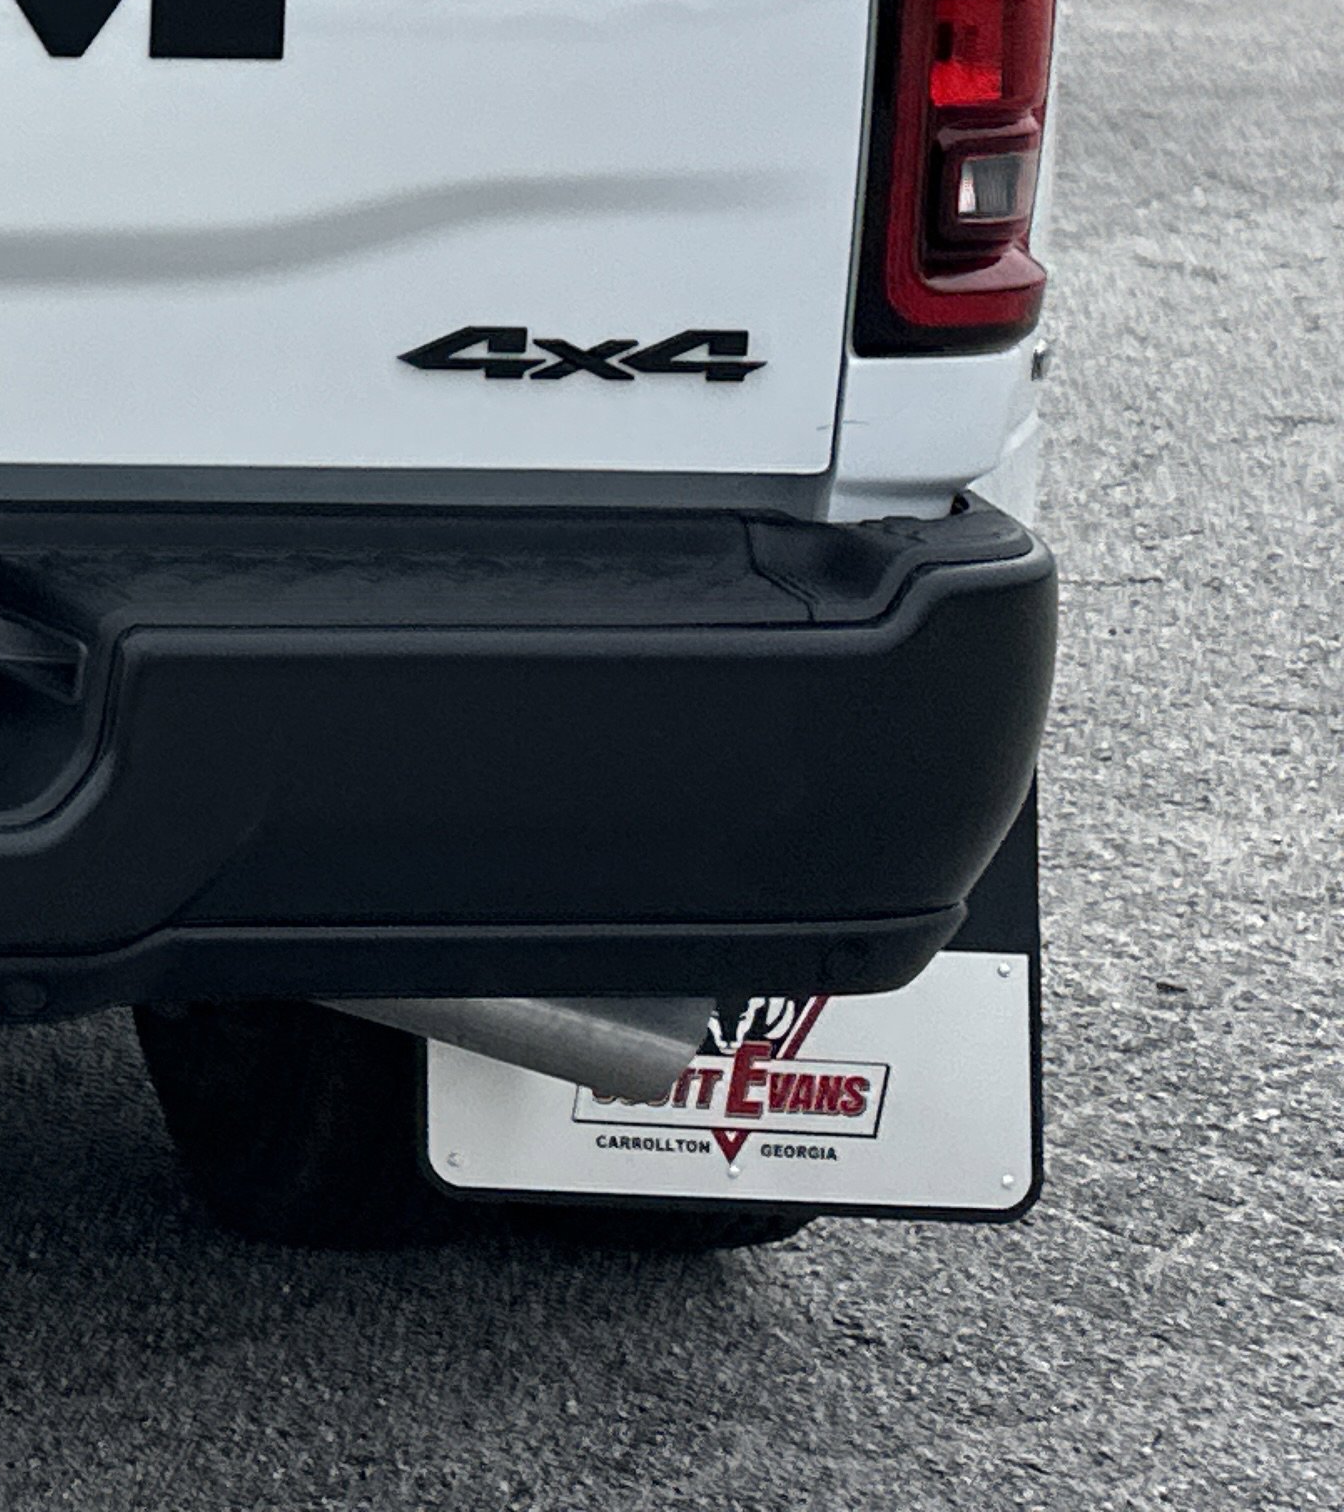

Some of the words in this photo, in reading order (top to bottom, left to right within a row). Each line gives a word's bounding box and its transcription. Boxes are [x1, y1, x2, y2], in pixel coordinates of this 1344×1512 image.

[724, 1041, 871, 1119] EVANS
[595, 1136, 711, 1155] CARROLLTON
[761, 1143, 837, 1161] GEORGIA
